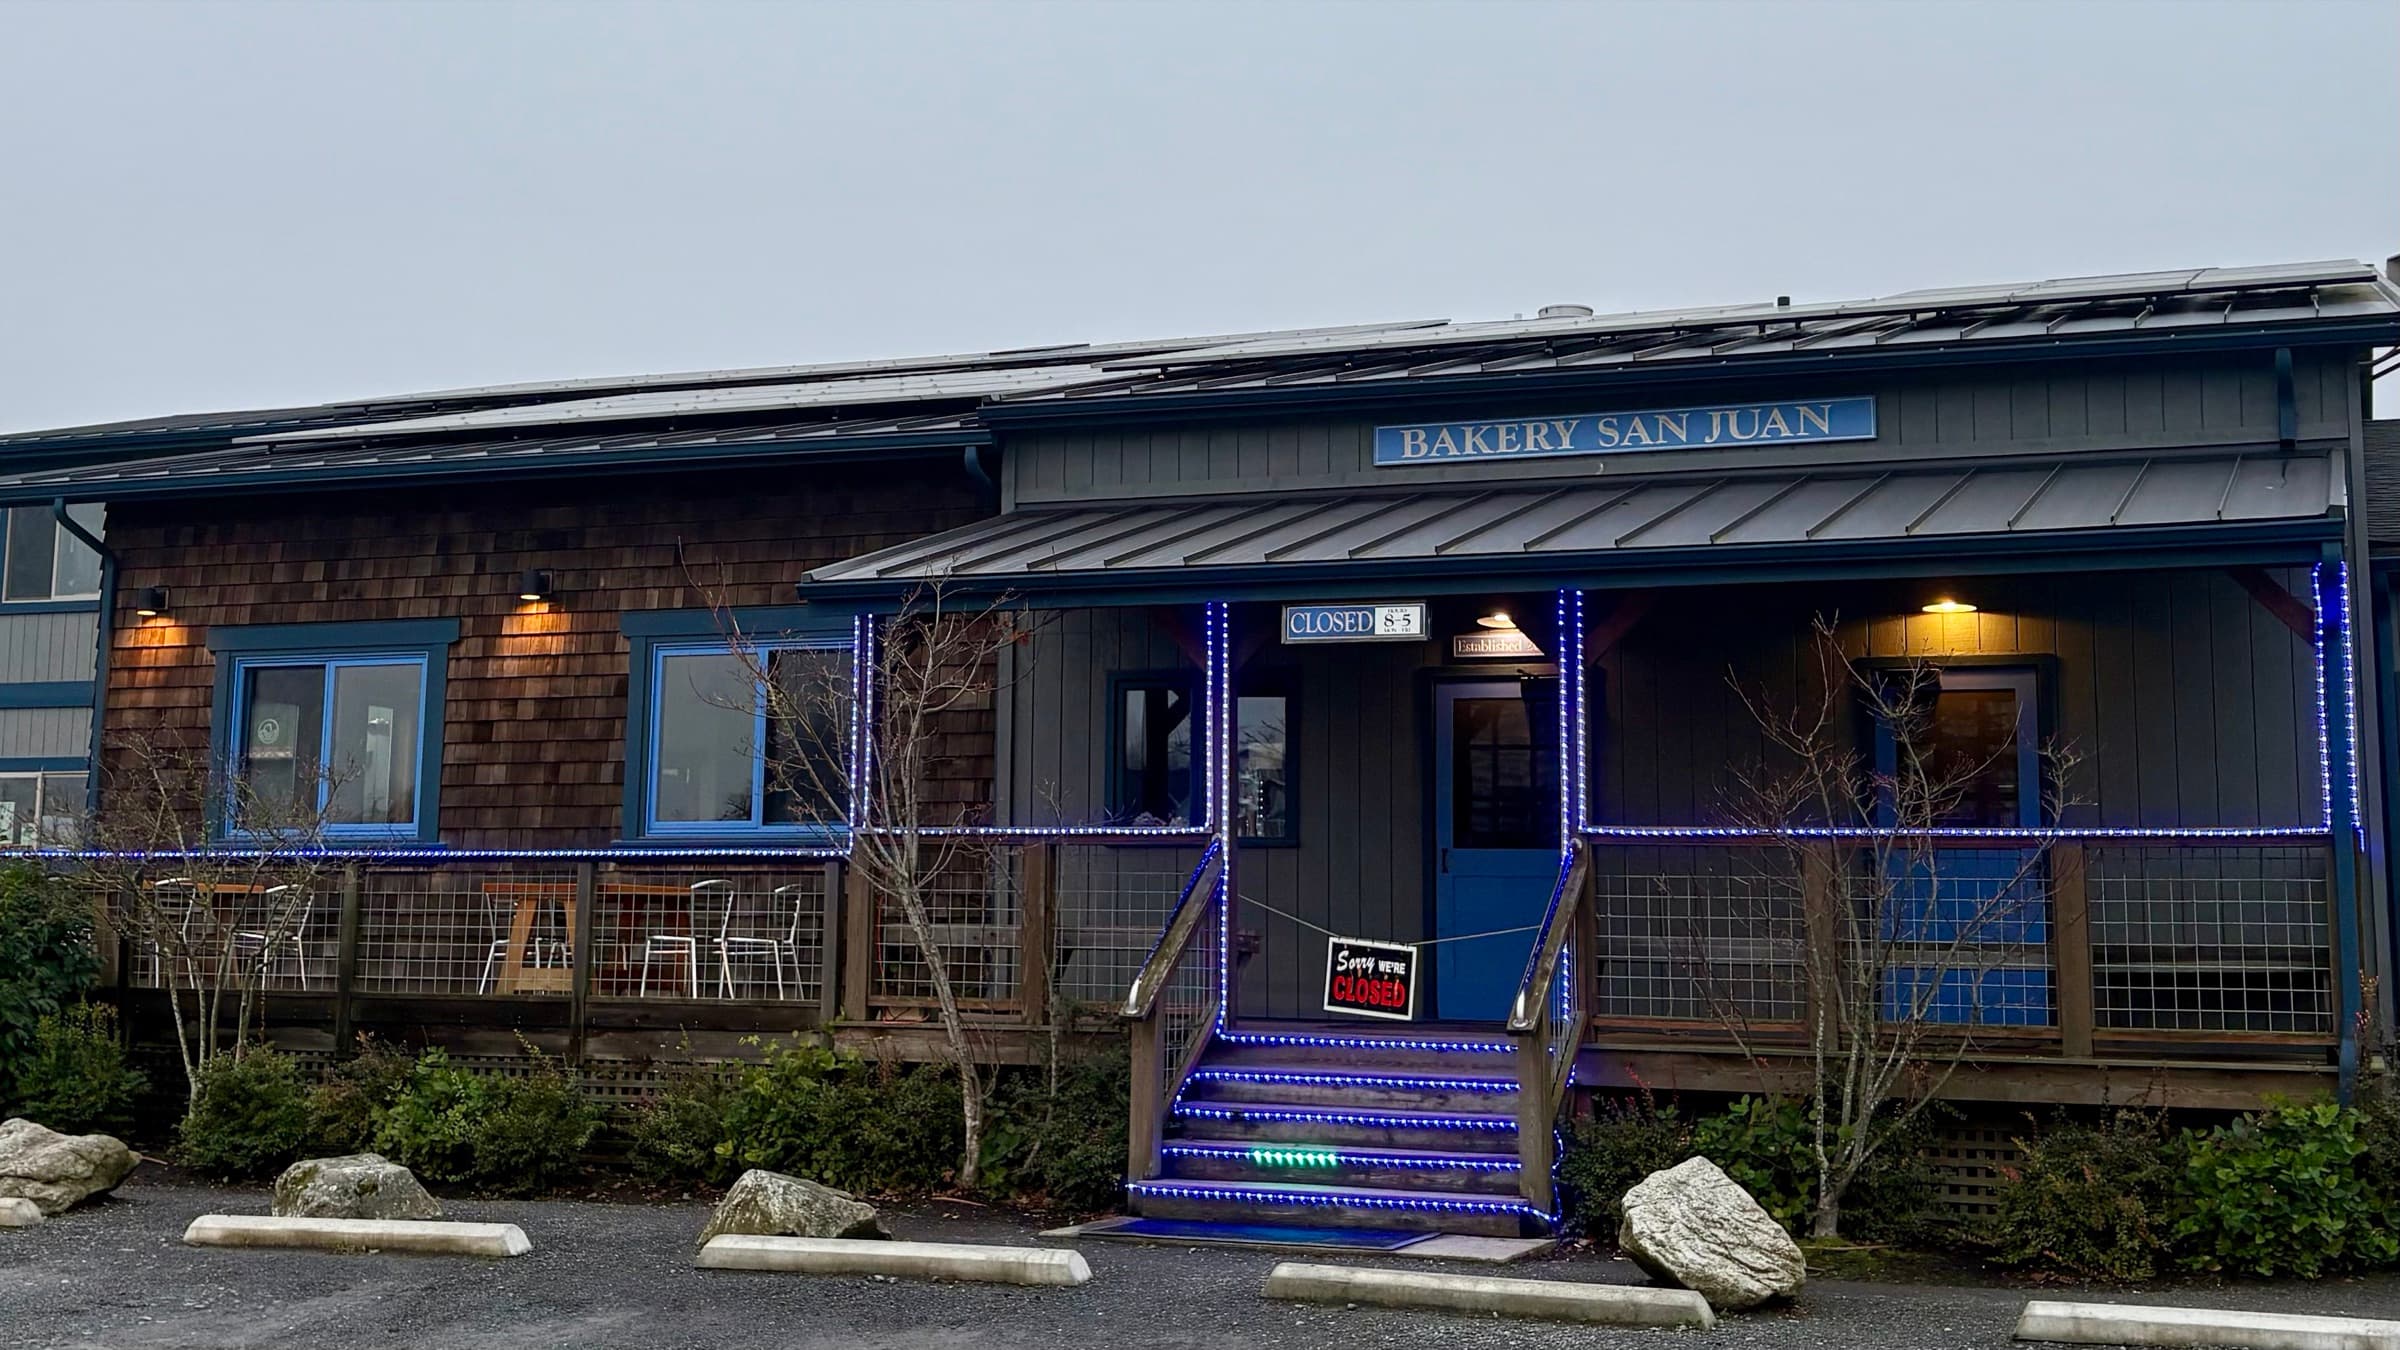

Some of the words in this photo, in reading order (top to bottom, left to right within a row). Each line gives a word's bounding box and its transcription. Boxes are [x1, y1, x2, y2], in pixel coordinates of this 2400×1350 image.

[1400, 420, 1580, 458] BAKERY
[1598, 413, 1690, 447] SAN
[1704, 404, 1832, 443] JUAN
[1290, 611, 1374, 634] CLOSED
[1384, 613, 1411, 627] 8-5
[1458, 639, 1522, 653] Established
[1336, 950, 1375, 975] Sorry
[1378, 960, 1406, 975] WE'RE
[1333, 975, 1405, 1008] CLOSED
